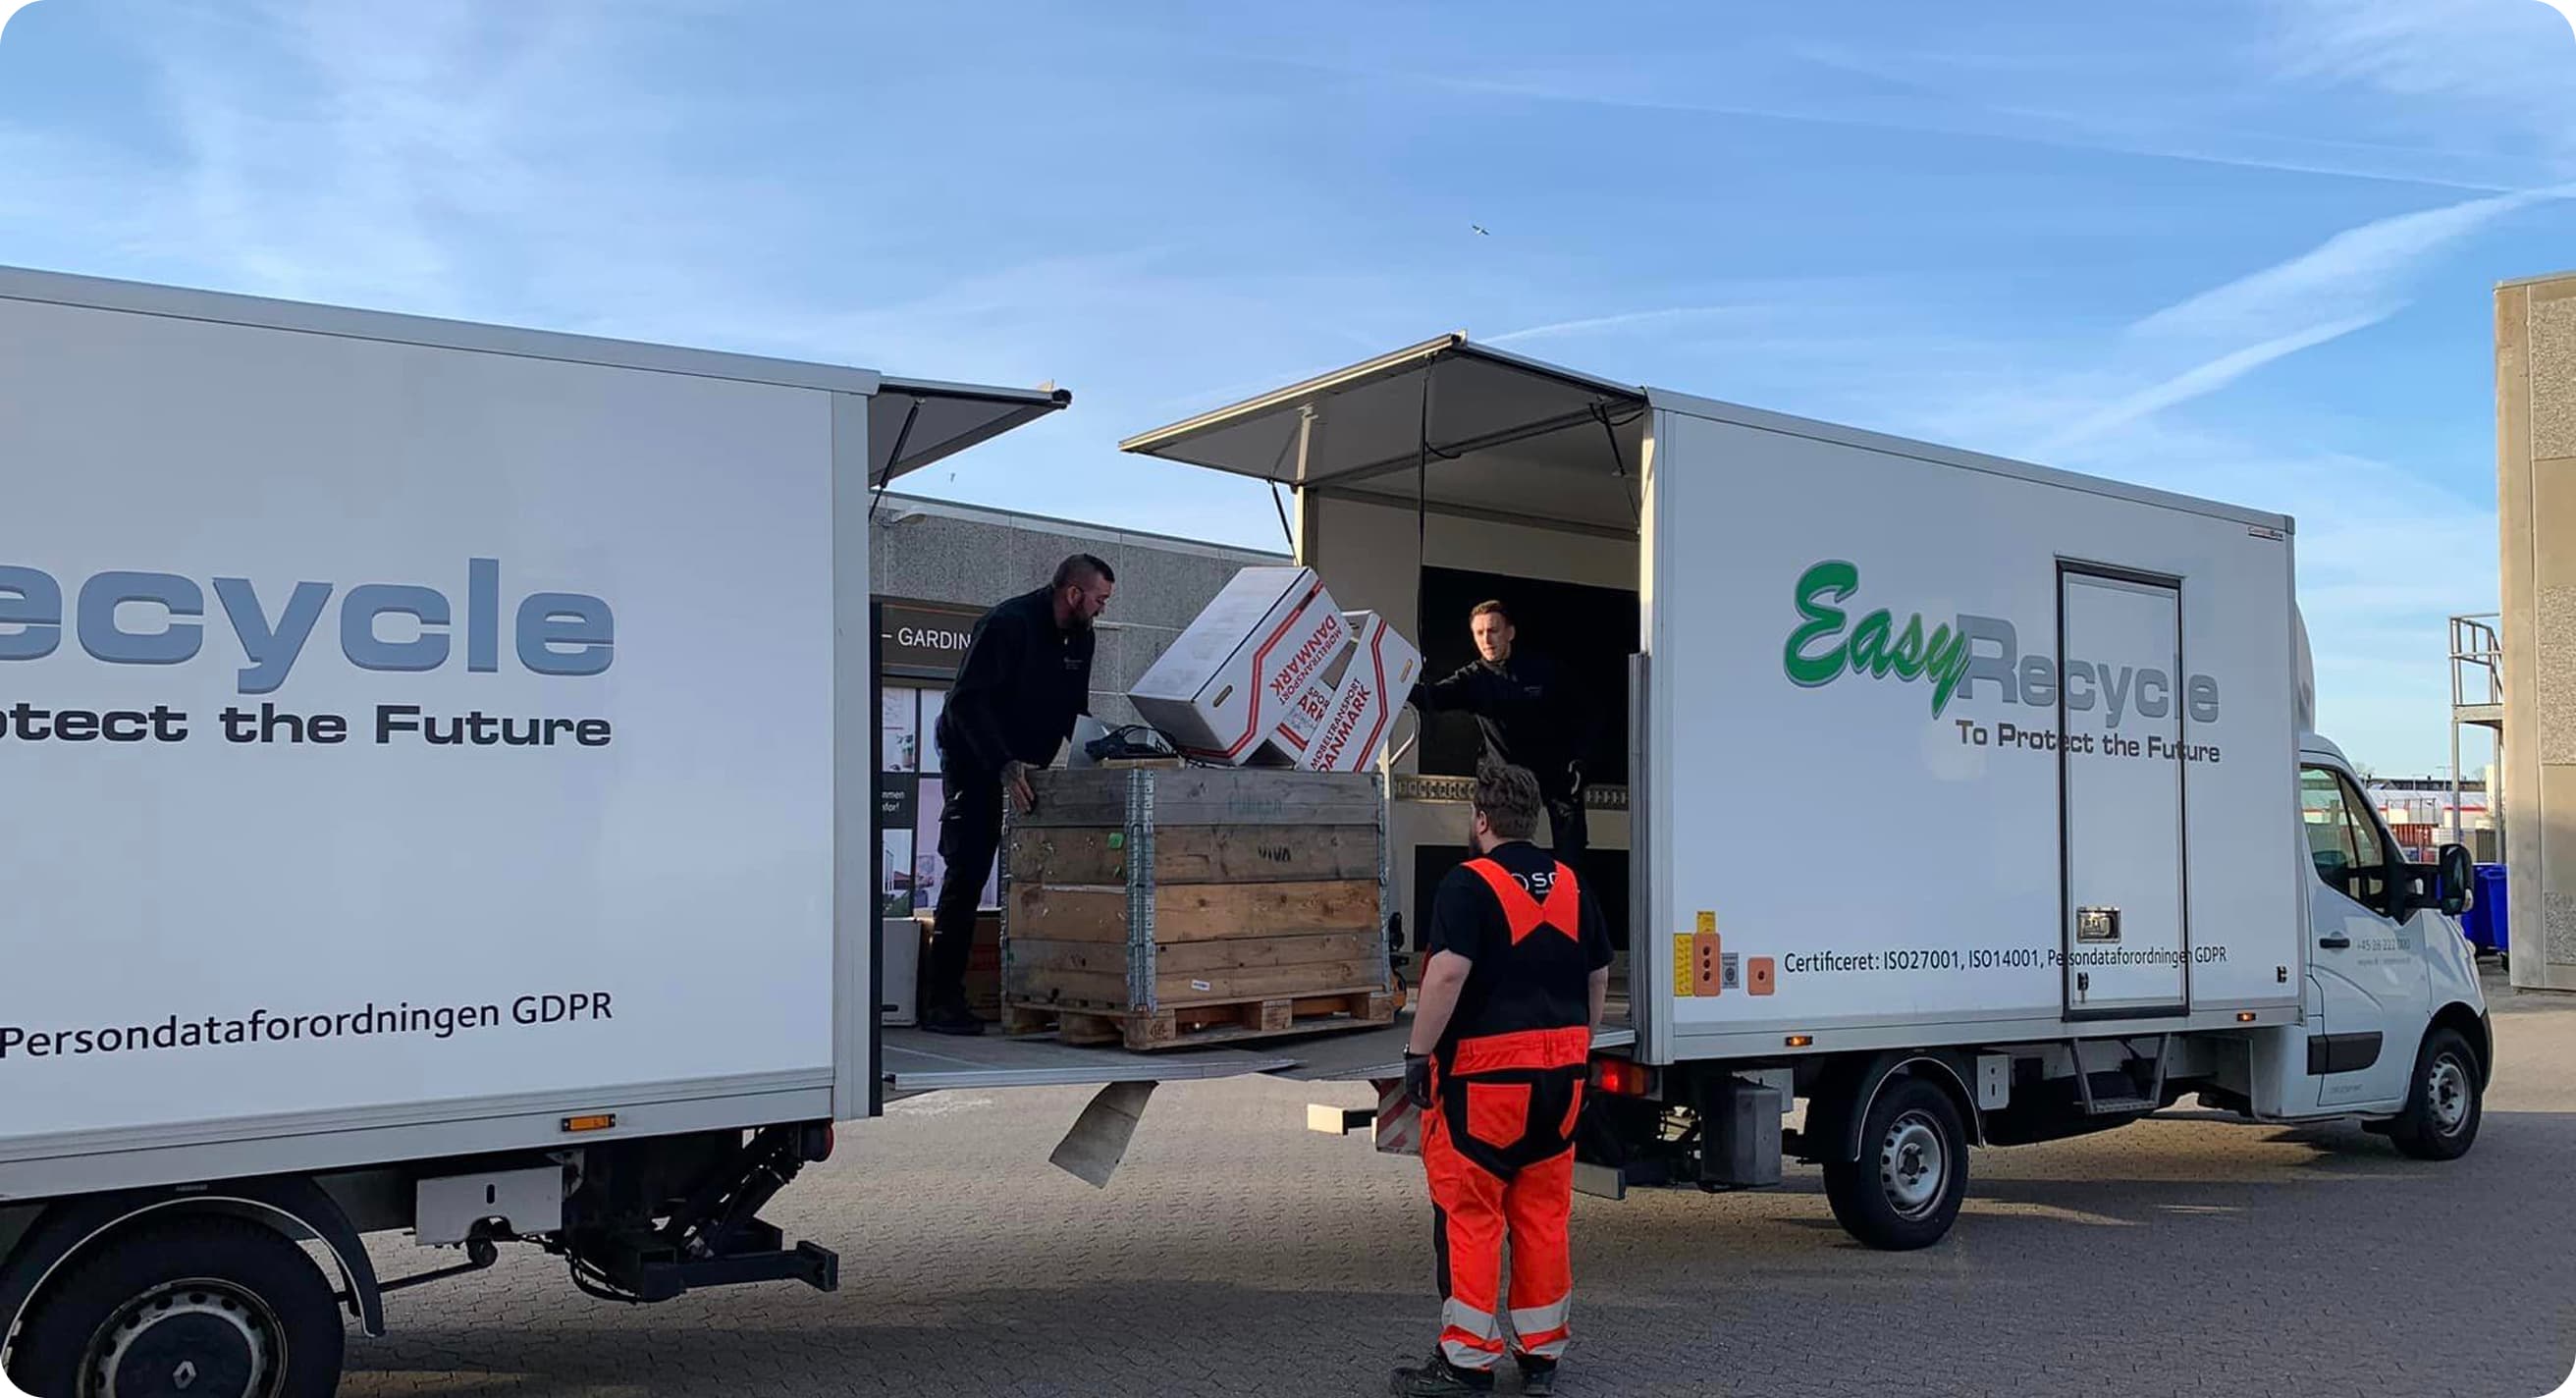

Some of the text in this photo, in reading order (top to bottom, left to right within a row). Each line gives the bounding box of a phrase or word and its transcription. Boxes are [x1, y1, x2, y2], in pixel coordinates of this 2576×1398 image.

[1268, 614, 1337, 696] DANMARK
[1783, 559, 1972, 720] Easy
[0, 702, 612, 746] tect the Future
[1956, 719, 2220, 763] To Protect the Future
[1785, 946, 2227, 973] Certificeret: ISO27001, ISO14001, Pesondataforordningen GDPR
[0, 992, 614, 1058] Persondataforordningen GDPR
